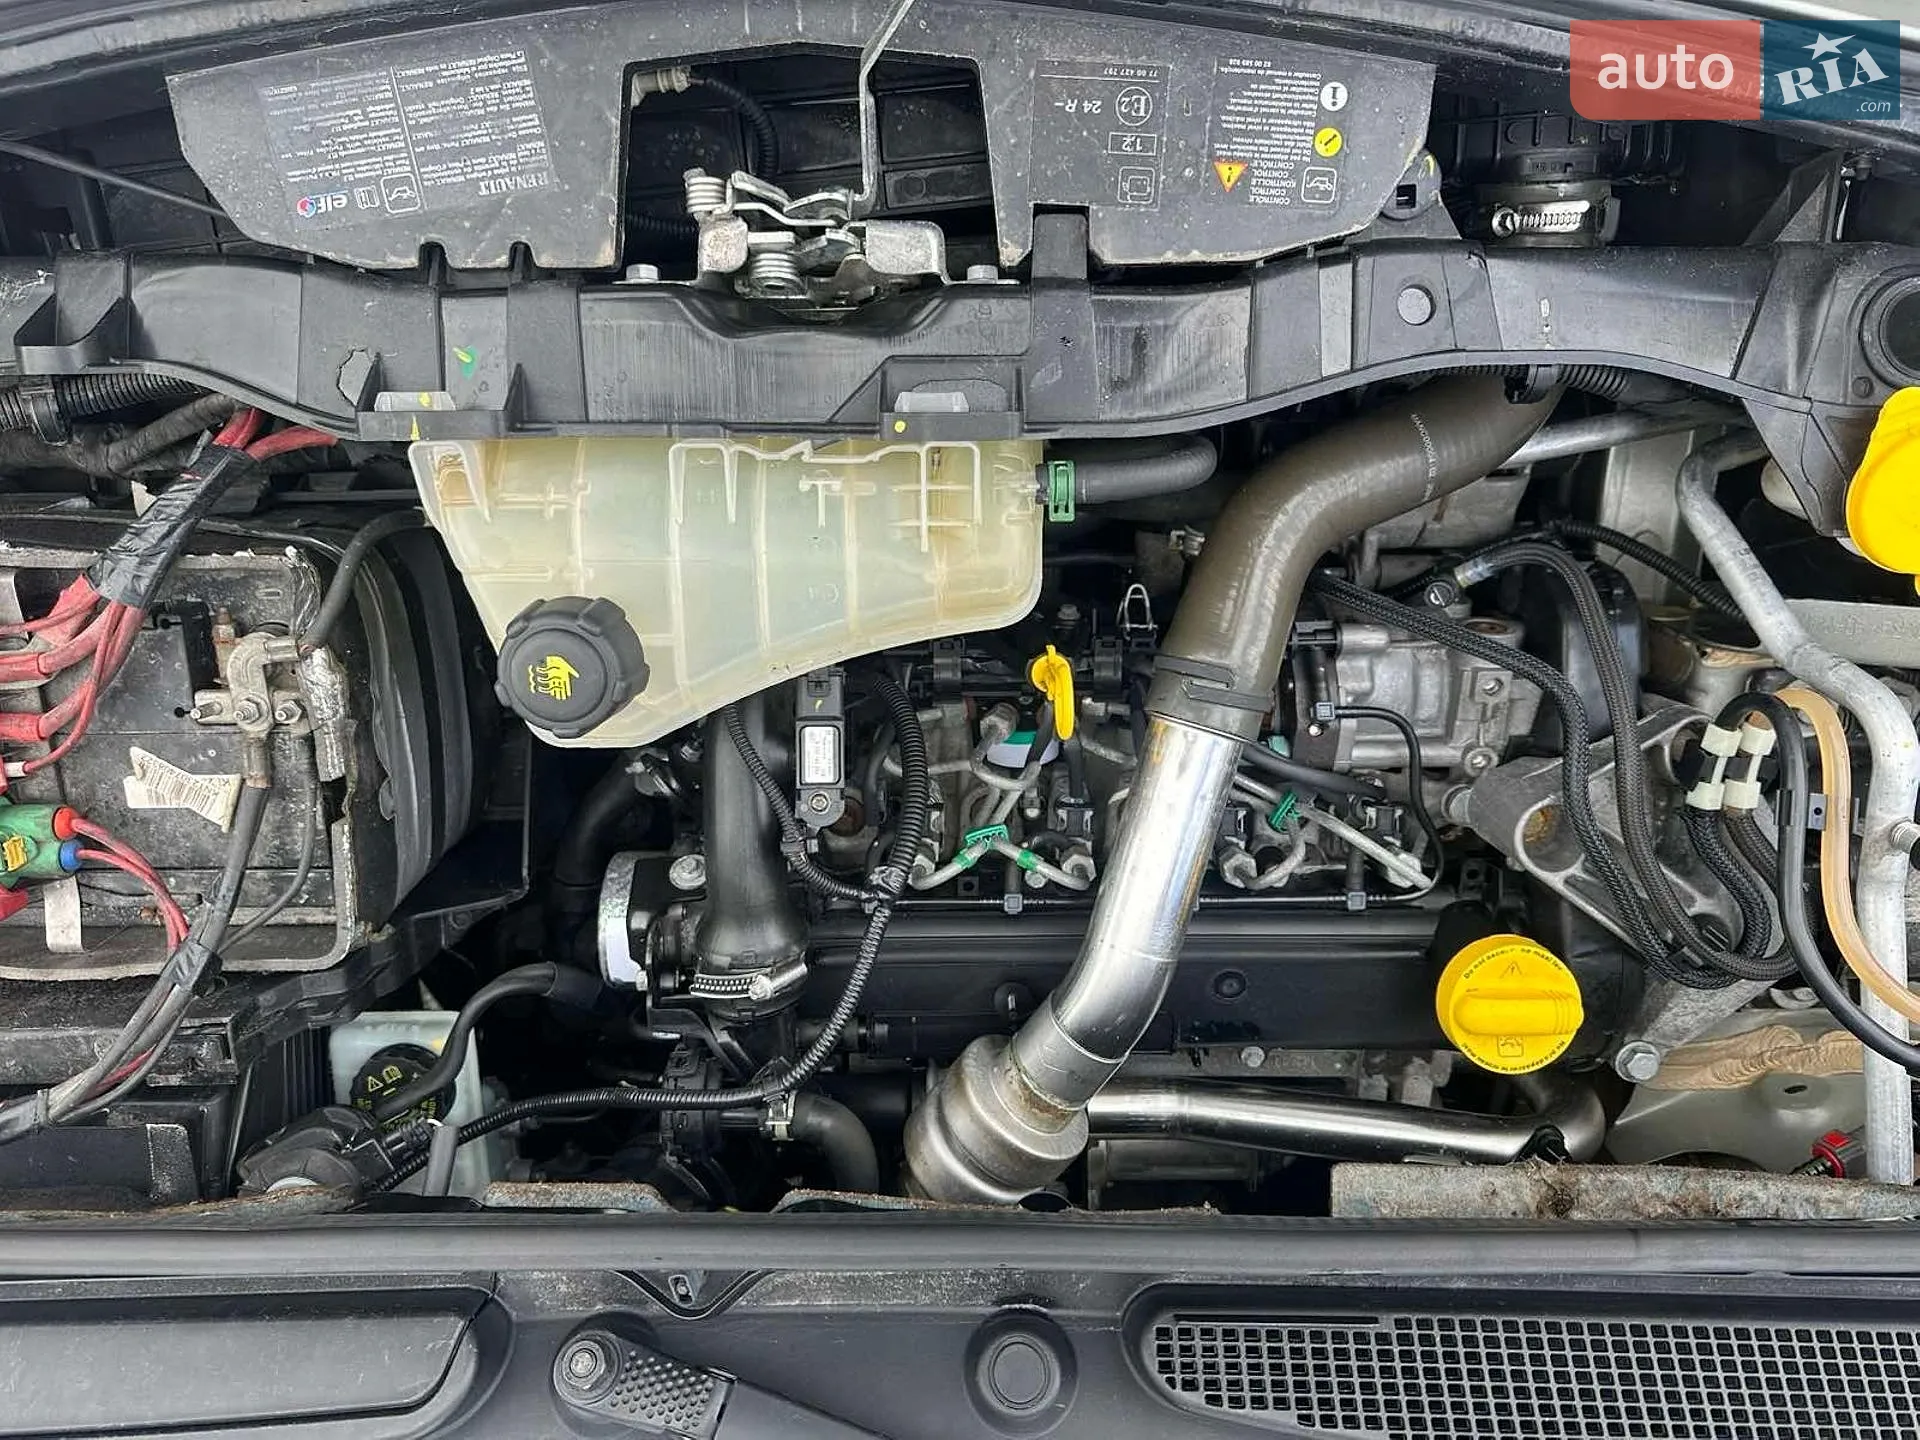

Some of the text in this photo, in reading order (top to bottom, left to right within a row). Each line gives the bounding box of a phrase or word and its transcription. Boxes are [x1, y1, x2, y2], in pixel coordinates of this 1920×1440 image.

[1081, 99, 1101, 113] 24
[1119, 94, 1147, 116] E2
[1251, 167, 1288, 178] CONTROL
[477, 171, 548, 195] RENAULT
[1250, 176, 1296, 188] KONTROLLE
[1249, 185, 1285, 196] CONTROL
[315, 193, 348, 213] elf
